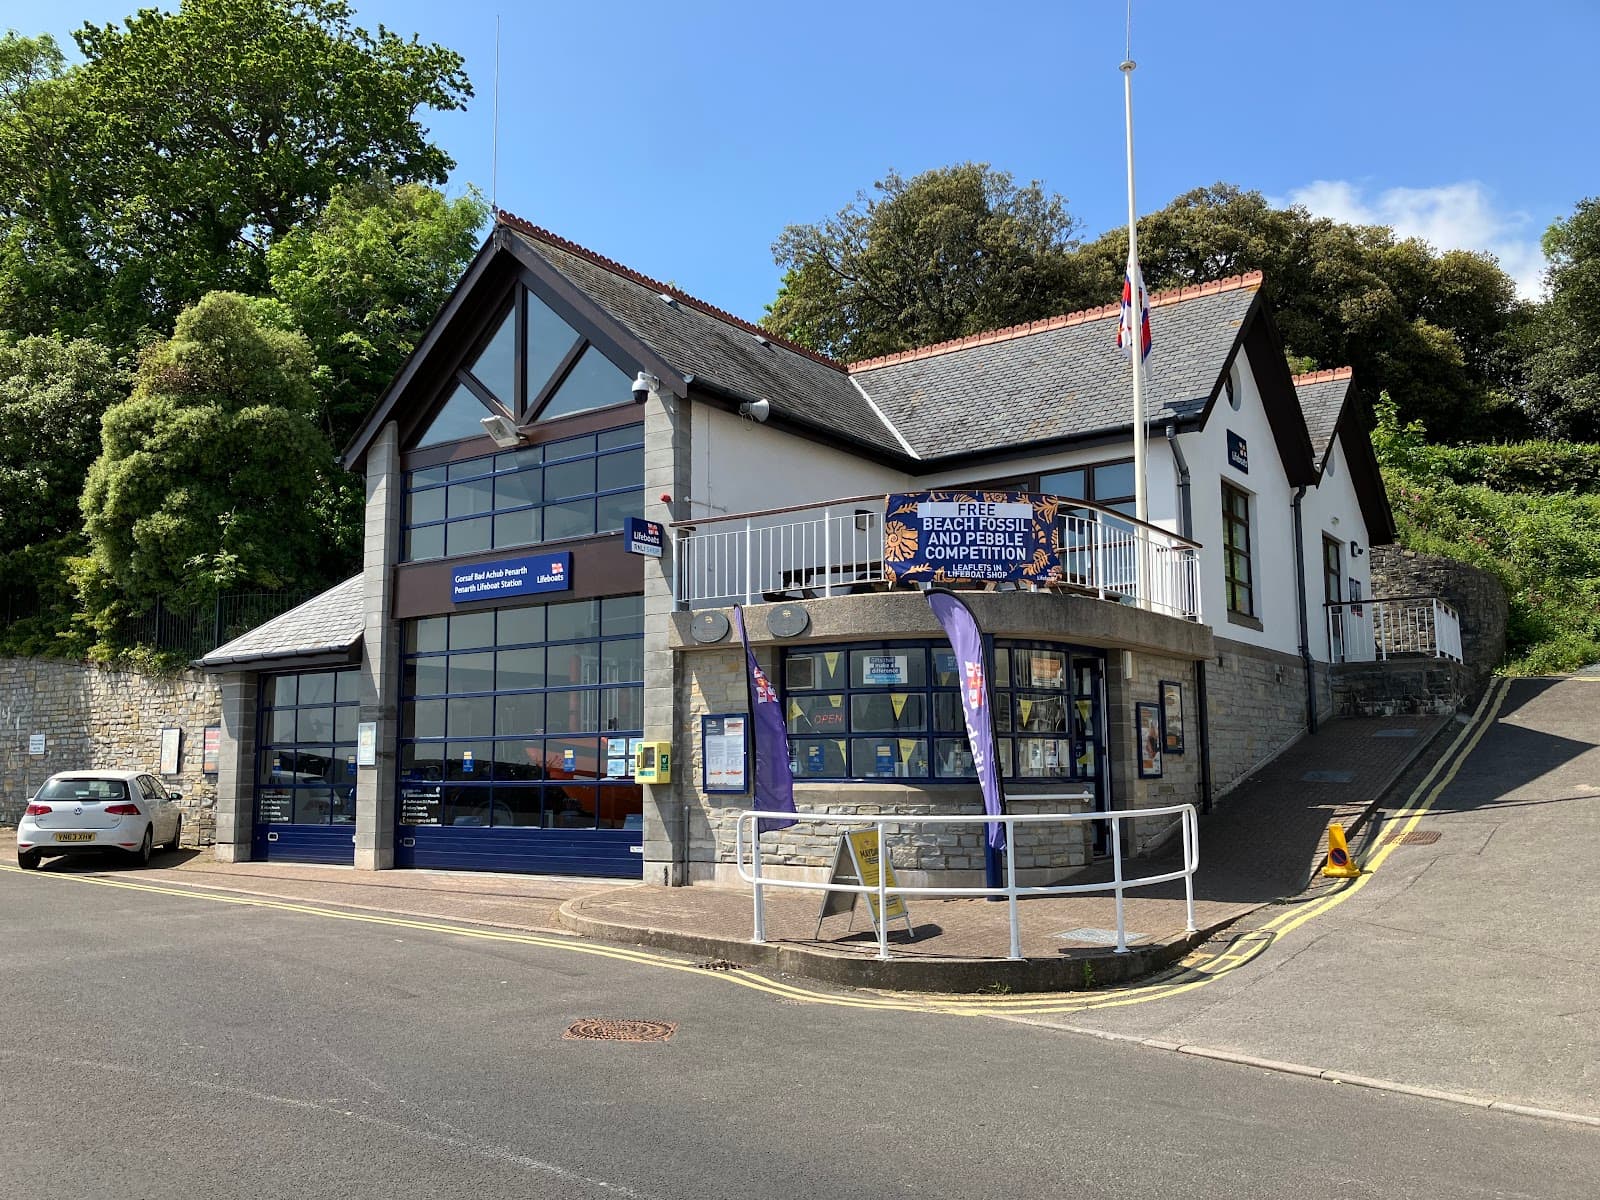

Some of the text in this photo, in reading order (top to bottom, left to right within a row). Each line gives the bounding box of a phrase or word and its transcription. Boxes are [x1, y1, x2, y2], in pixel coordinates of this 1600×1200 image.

[958, 503, 996, 516] FREE
[922, 517, 1029, 532] BEACH FOSSIL
[633, 531, 660, 544] Lifeboats
[928, 531, 1024, 546] AND PEBBLE
[925, 546, 1026, 561] COMPETITION
[952, 563, 1002, 572] LEAFLETS IN
[455, 565, 528, 584] Gorsaf Bad Achub Penarth
[537, 573, 564, 584] Lifeboats
[947, 570, 1008, 579] LIFEBOAT SHOP
[454, 578, 523, 595] Penarth Lifeboat Station
[815, 713, 842, 724] OPEN
[77, 832, 93, 841] XHW
